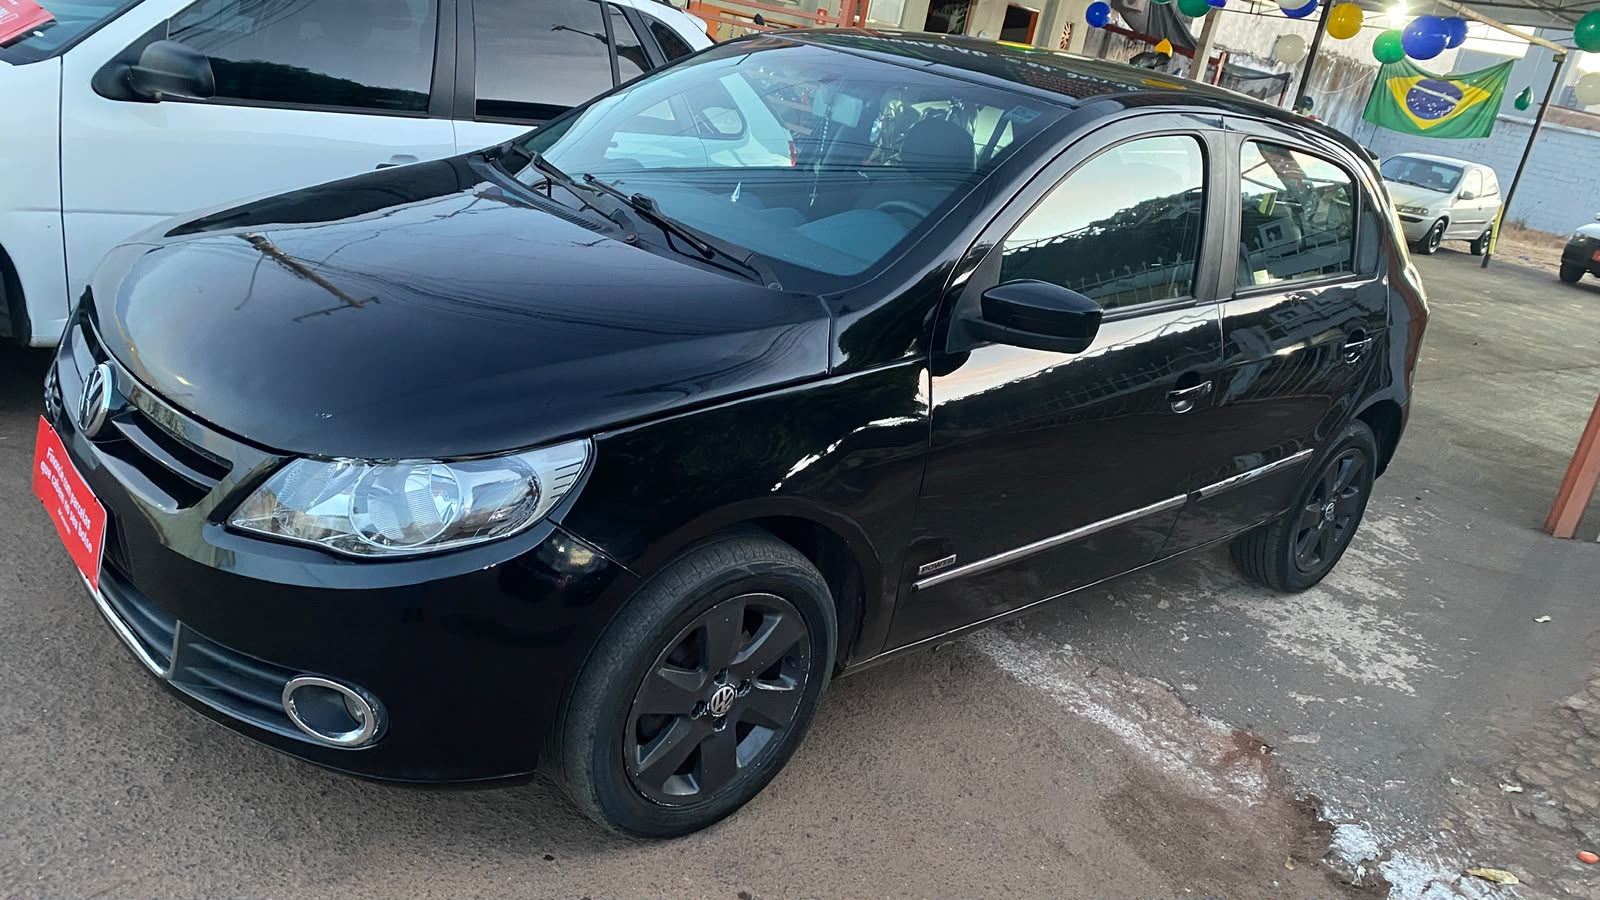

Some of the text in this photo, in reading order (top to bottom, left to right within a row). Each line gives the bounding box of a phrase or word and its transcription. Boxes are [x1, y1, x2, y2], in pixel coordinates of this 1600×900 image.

[40, 461, 51, 480] que
[70, 510, 78, 531] seu
[78, 521, 93, 553] bolso
[70, 492, 91, 531] parcelas
[921, 557, 955, 573] POWER
